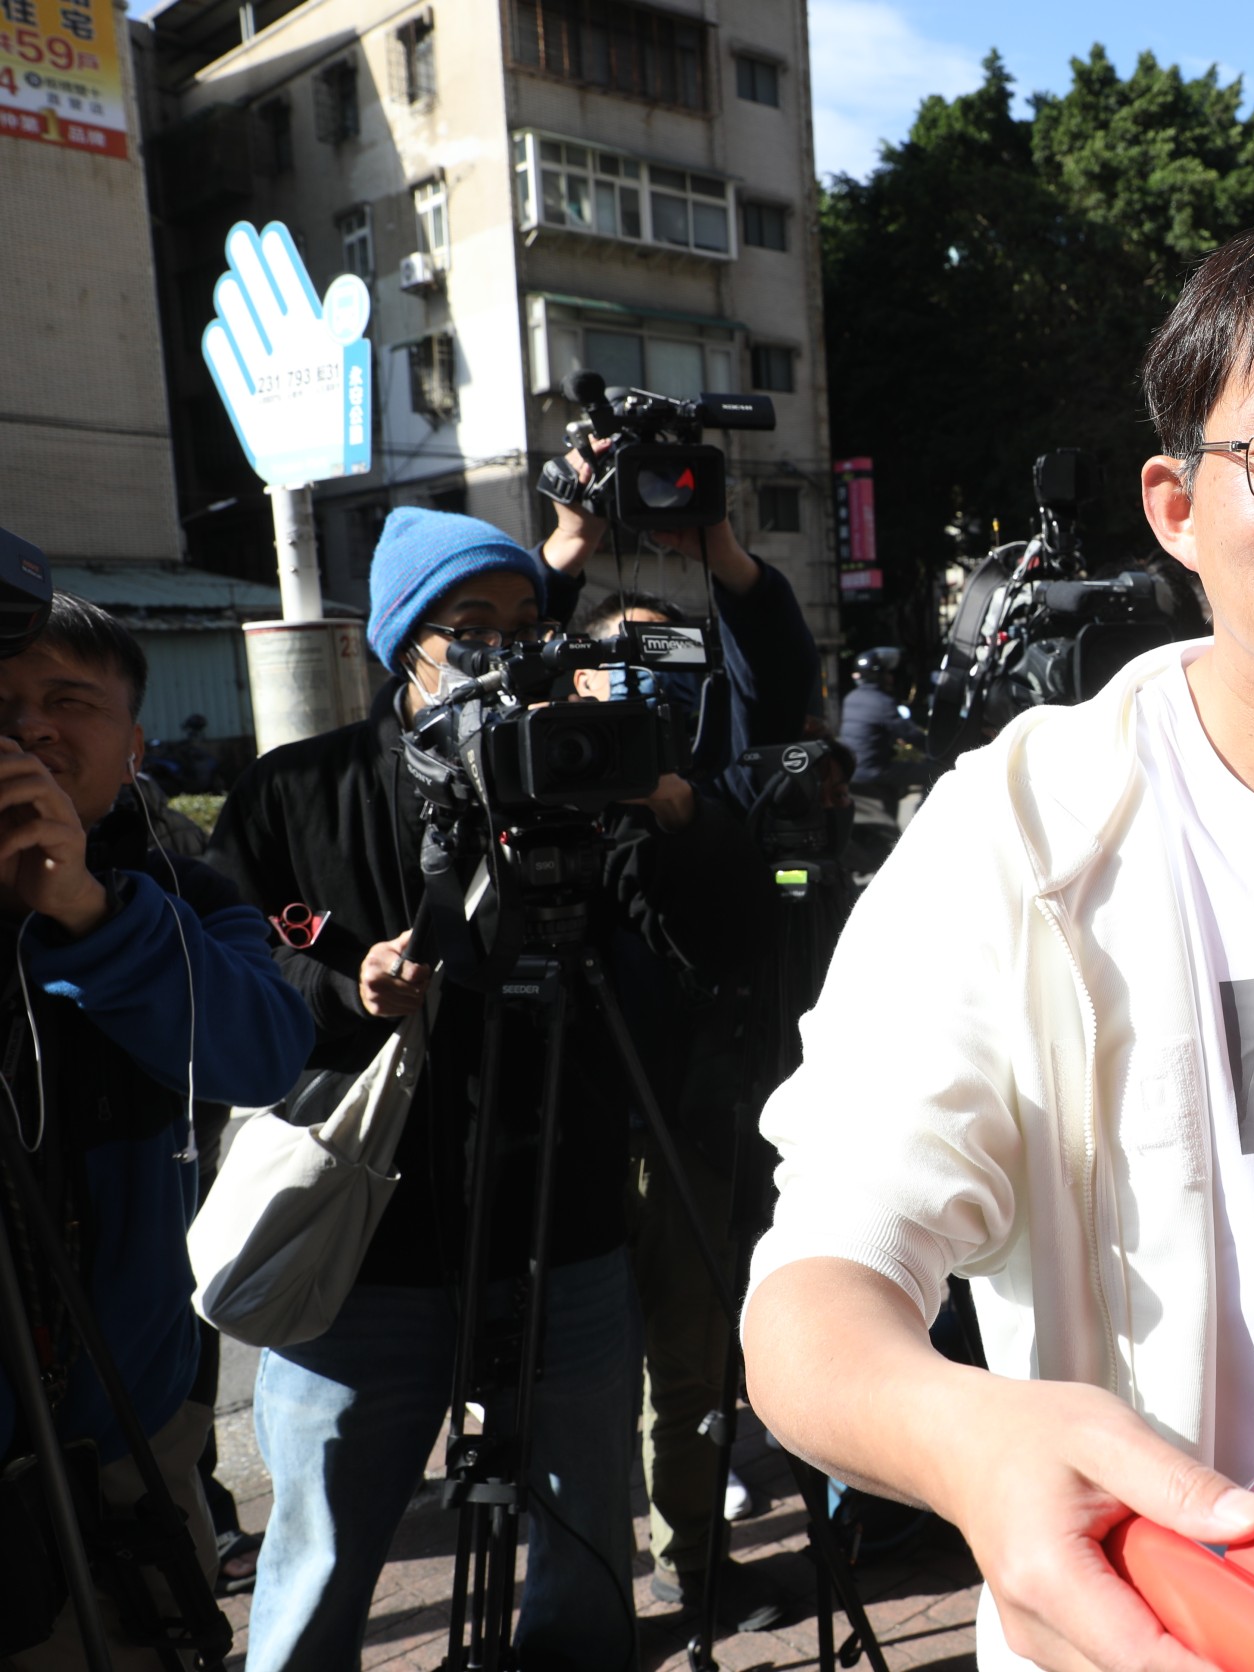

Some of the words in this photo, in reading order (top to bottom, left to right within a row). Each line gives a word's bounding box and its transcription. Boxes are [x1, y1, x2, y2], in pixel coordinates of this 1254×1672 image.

[406, 763, 433, 786] SONY
[534, 860, 555, 871] S90
[502, 984, 540, 995] SEEDER
